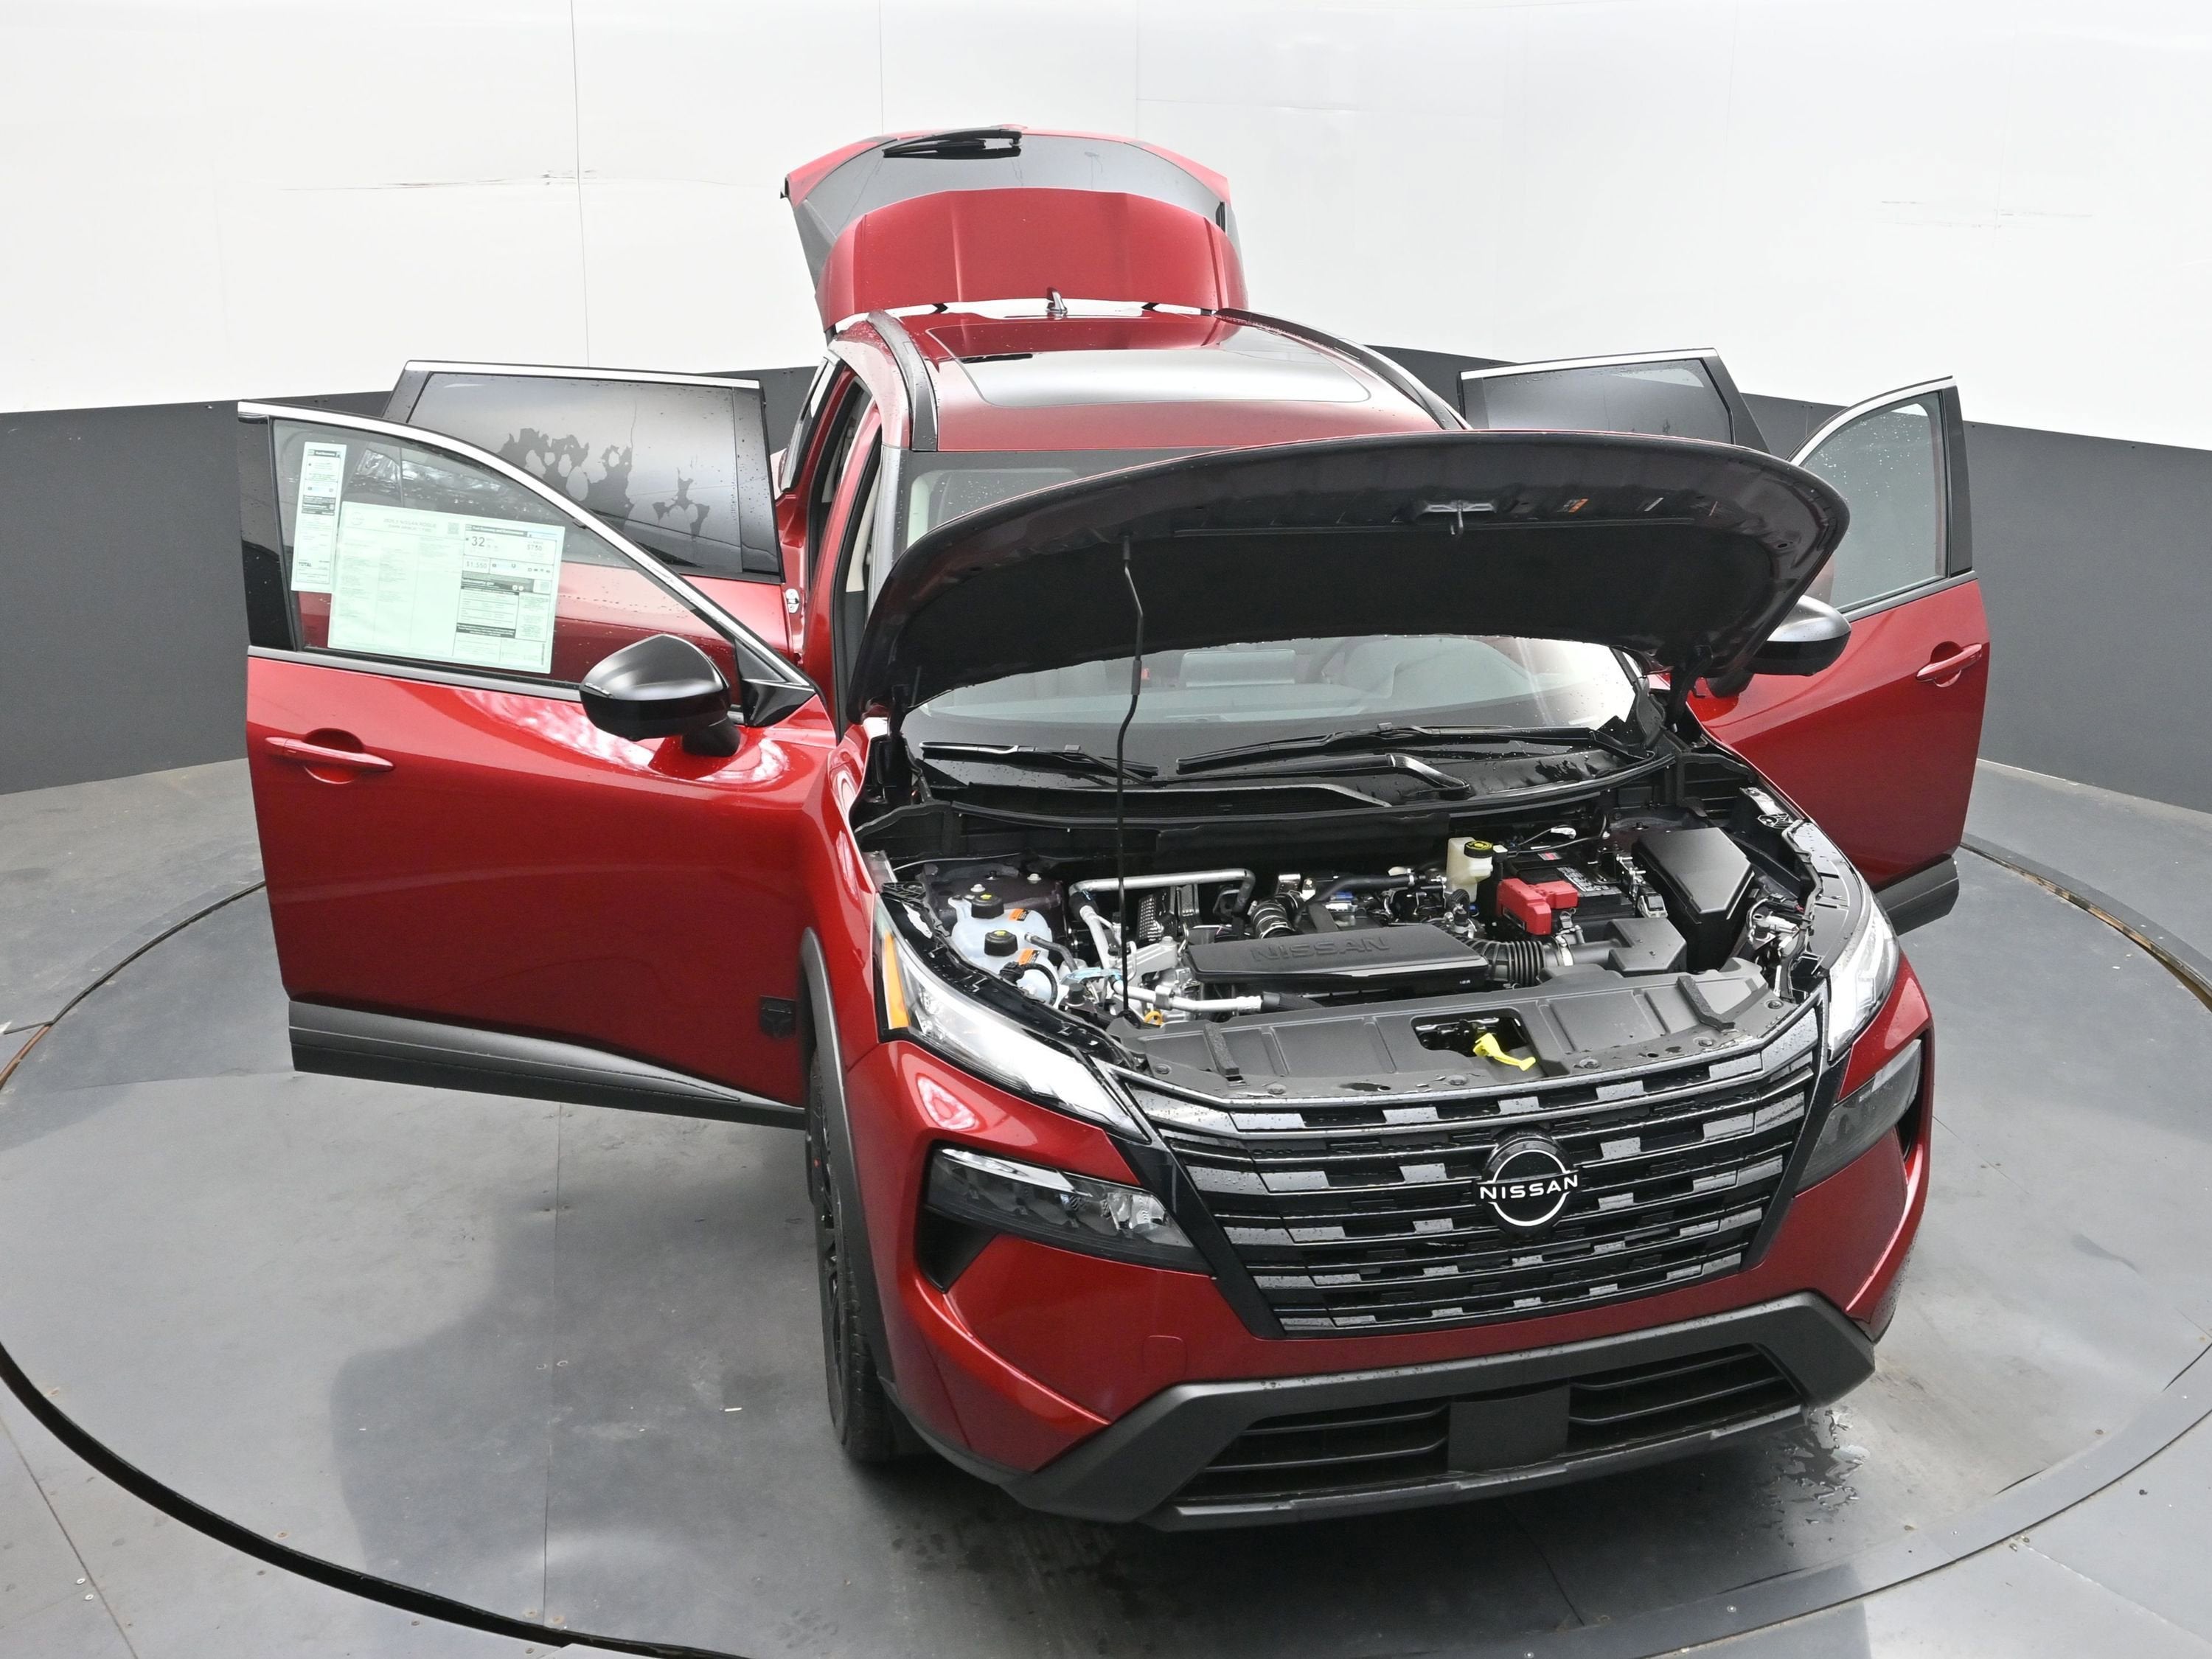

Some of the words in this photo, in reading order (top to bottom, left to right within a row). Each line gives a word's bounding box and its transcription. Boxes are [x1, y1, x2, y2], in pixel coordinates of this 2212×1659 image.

[471, 536, 485, 547] 32
[1251, 936, 1390, 961] NISSAN
[1480, 1175, 1578, 1199] NISSAN
